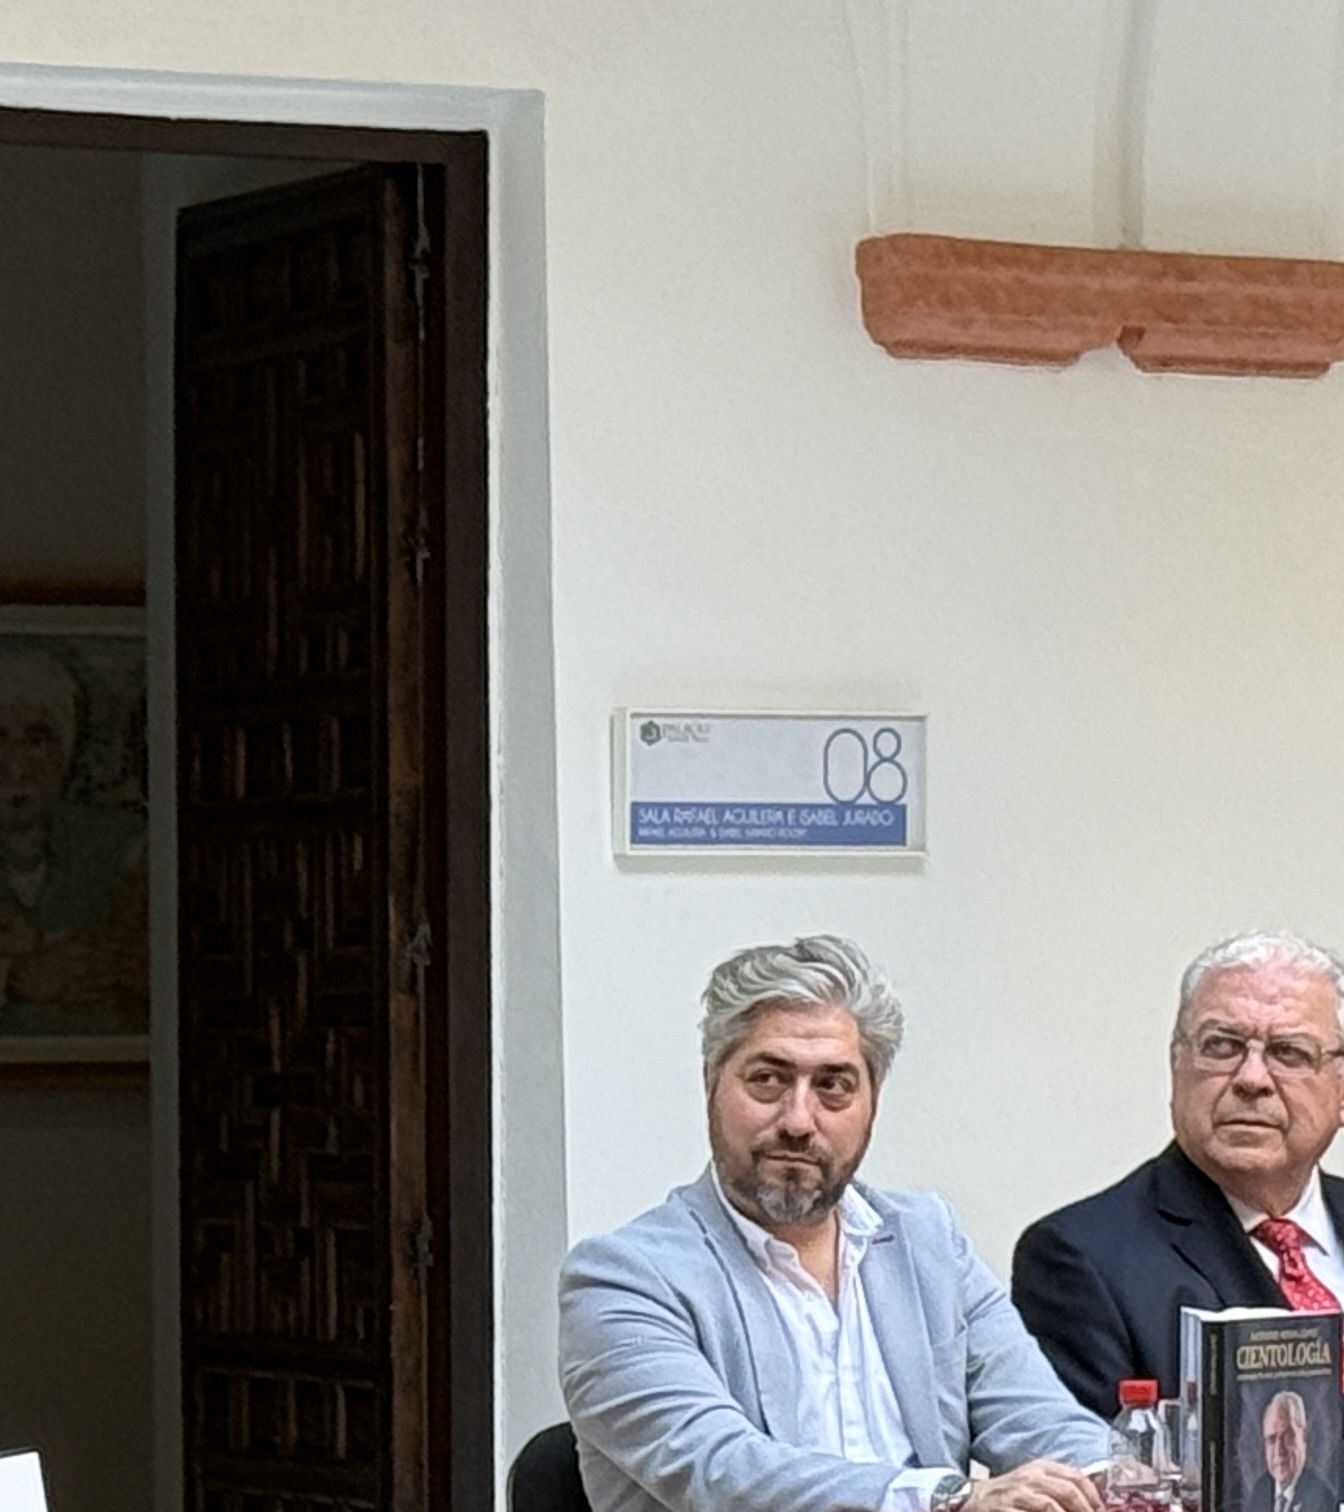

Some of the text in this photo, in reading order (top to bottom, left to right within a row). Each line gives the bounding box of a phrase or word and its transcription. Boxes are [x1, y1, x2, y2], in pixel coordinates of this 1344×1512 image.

[823, 727, 908, 804] 08
[639, 807, 670, 824] SALA
[673, 807, 718, 824] RAFAEL
[799, 809, 838, 826] ISABEL
[842, 811, 895, 827] JURADO
[1236, 1337, 1332, 1370] CIENTOLOGÍA
